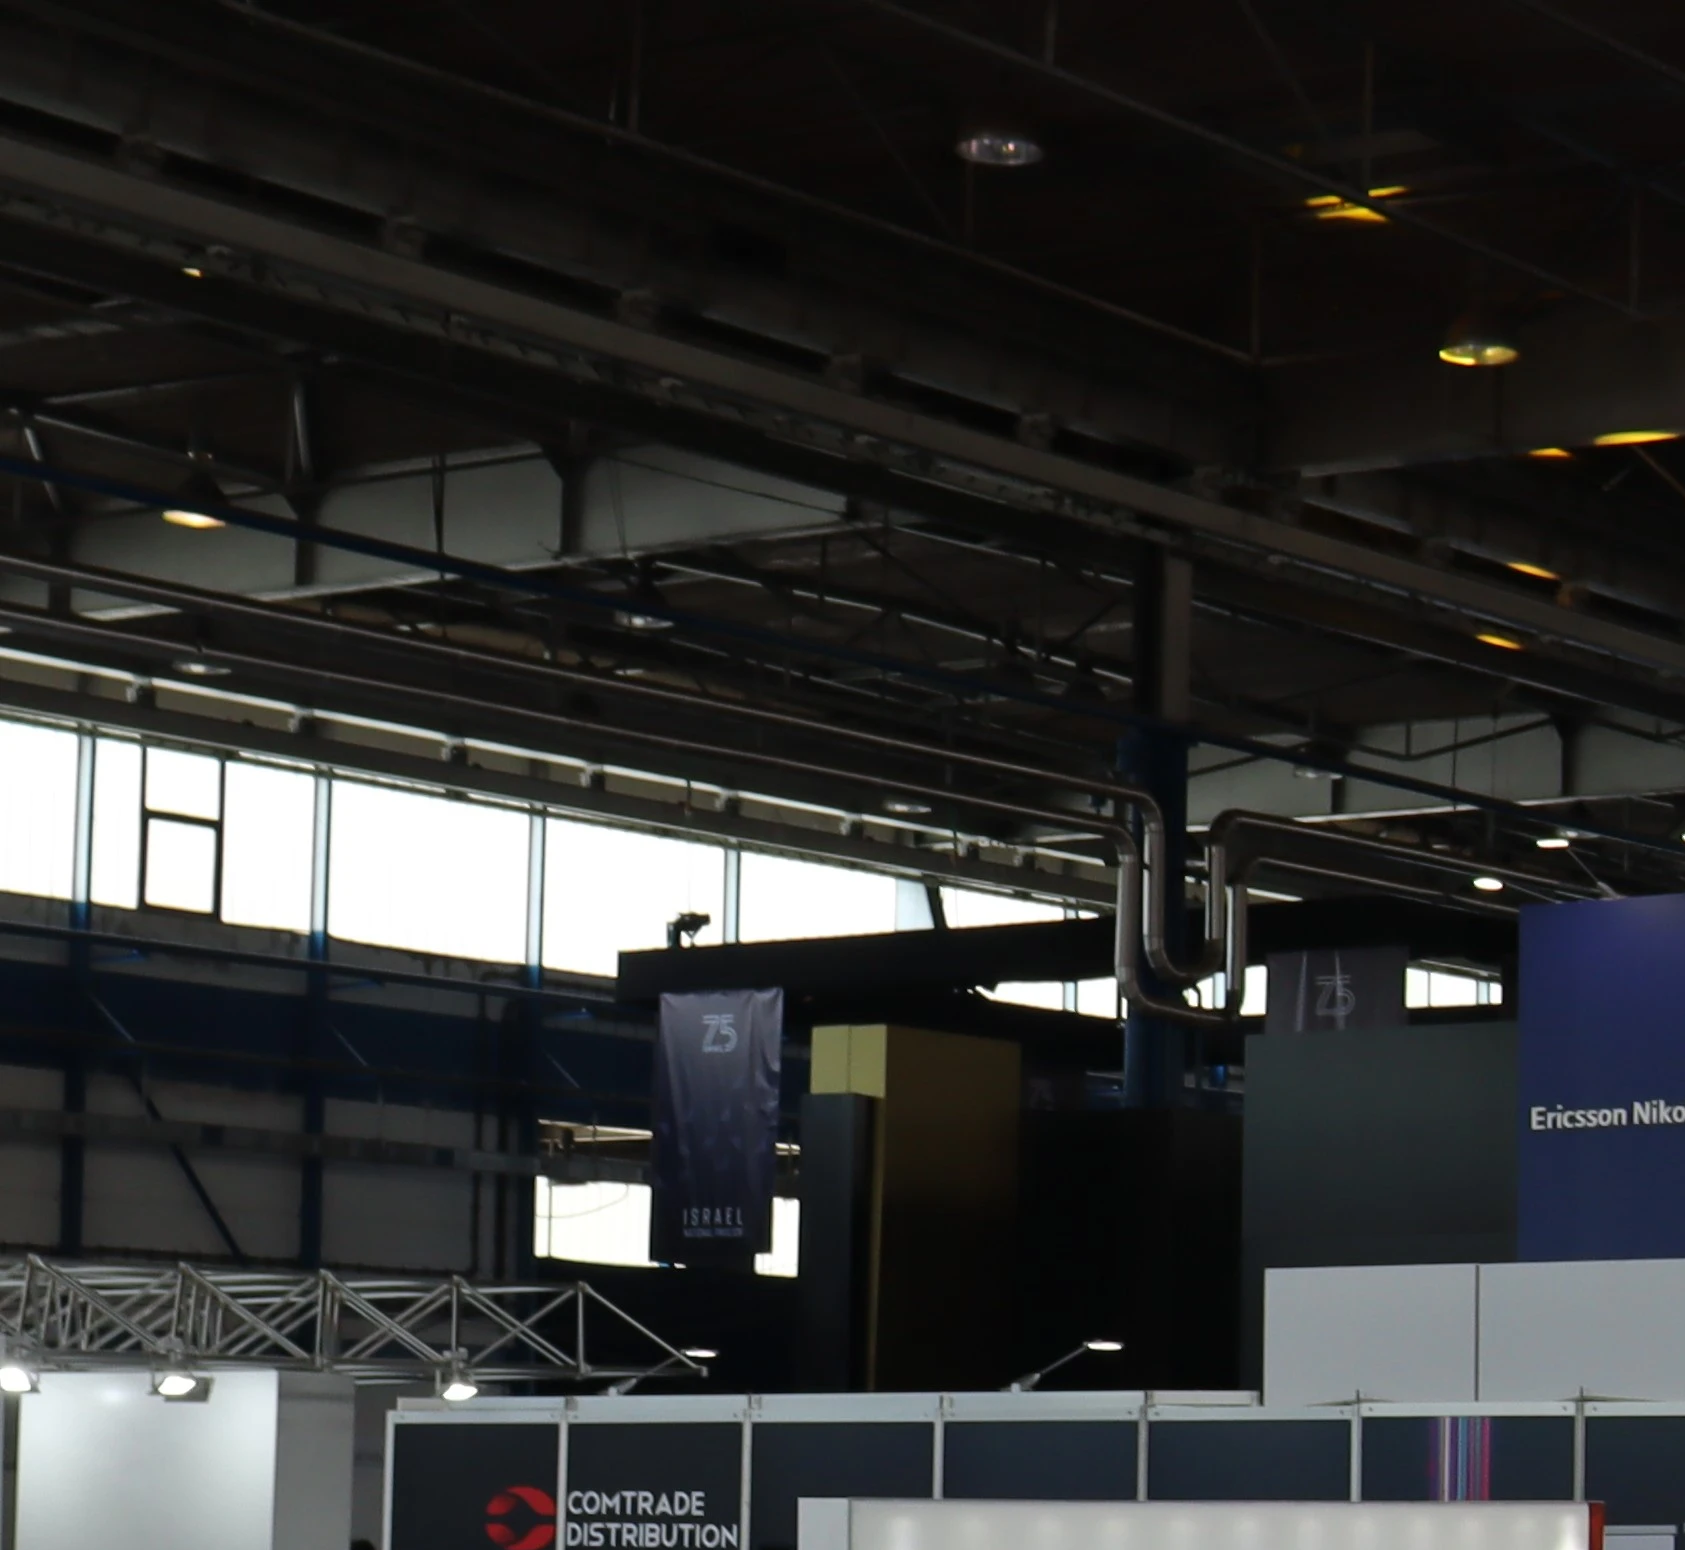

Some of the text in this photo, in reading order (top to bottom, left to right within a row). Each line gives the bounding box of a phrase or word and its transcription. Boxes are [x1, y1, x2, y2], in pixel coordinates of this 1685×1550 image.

[1529, 1105, 1627, 1131] Ericsson
[682, 1206, 744, 1227] ISRAEL
[567, 1490, 705, 1517] COMTRADE
[566, 1521, 739, 1548] DISTRIBUTION
